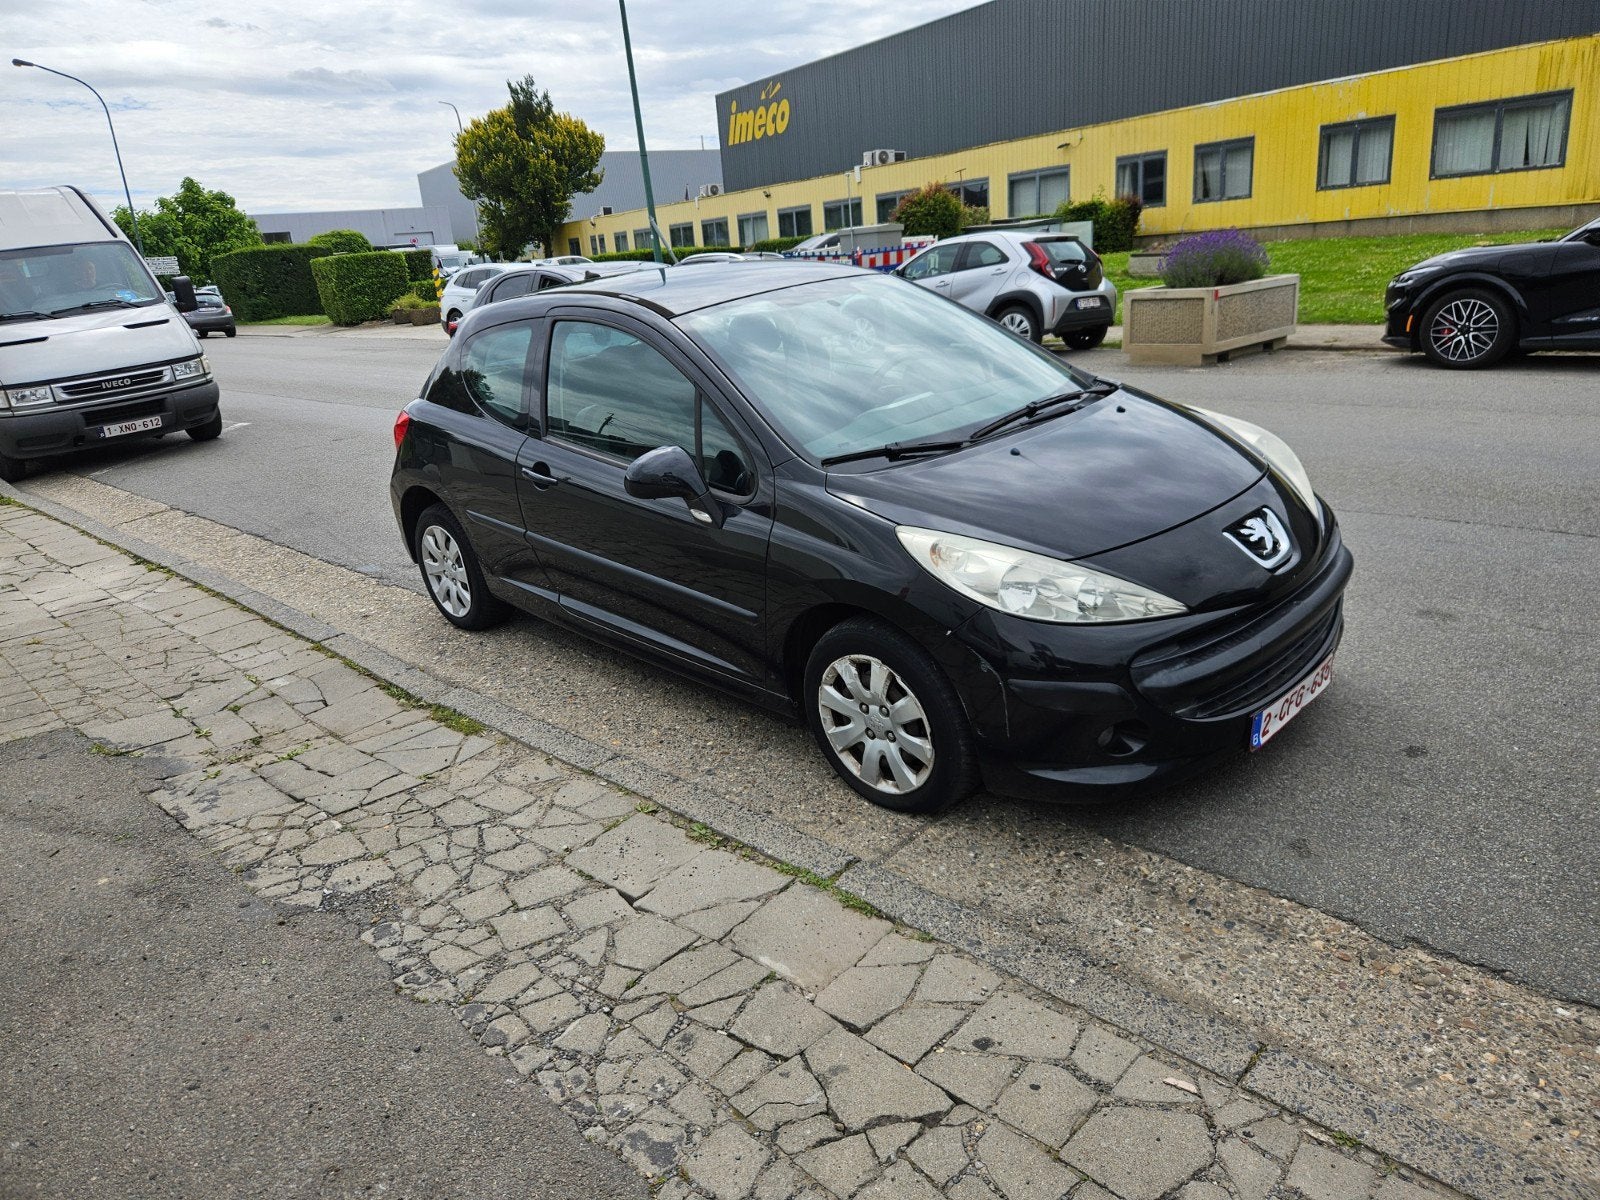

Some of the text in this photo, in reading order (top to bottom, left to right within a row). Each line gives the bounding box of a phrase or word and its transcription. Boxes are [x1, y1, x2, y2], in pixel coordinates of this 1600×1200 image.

[728, 99, 790, 146] imeco
[101, 378, 131, 389] IVECO
[1252, 733, 1259, 746] B
